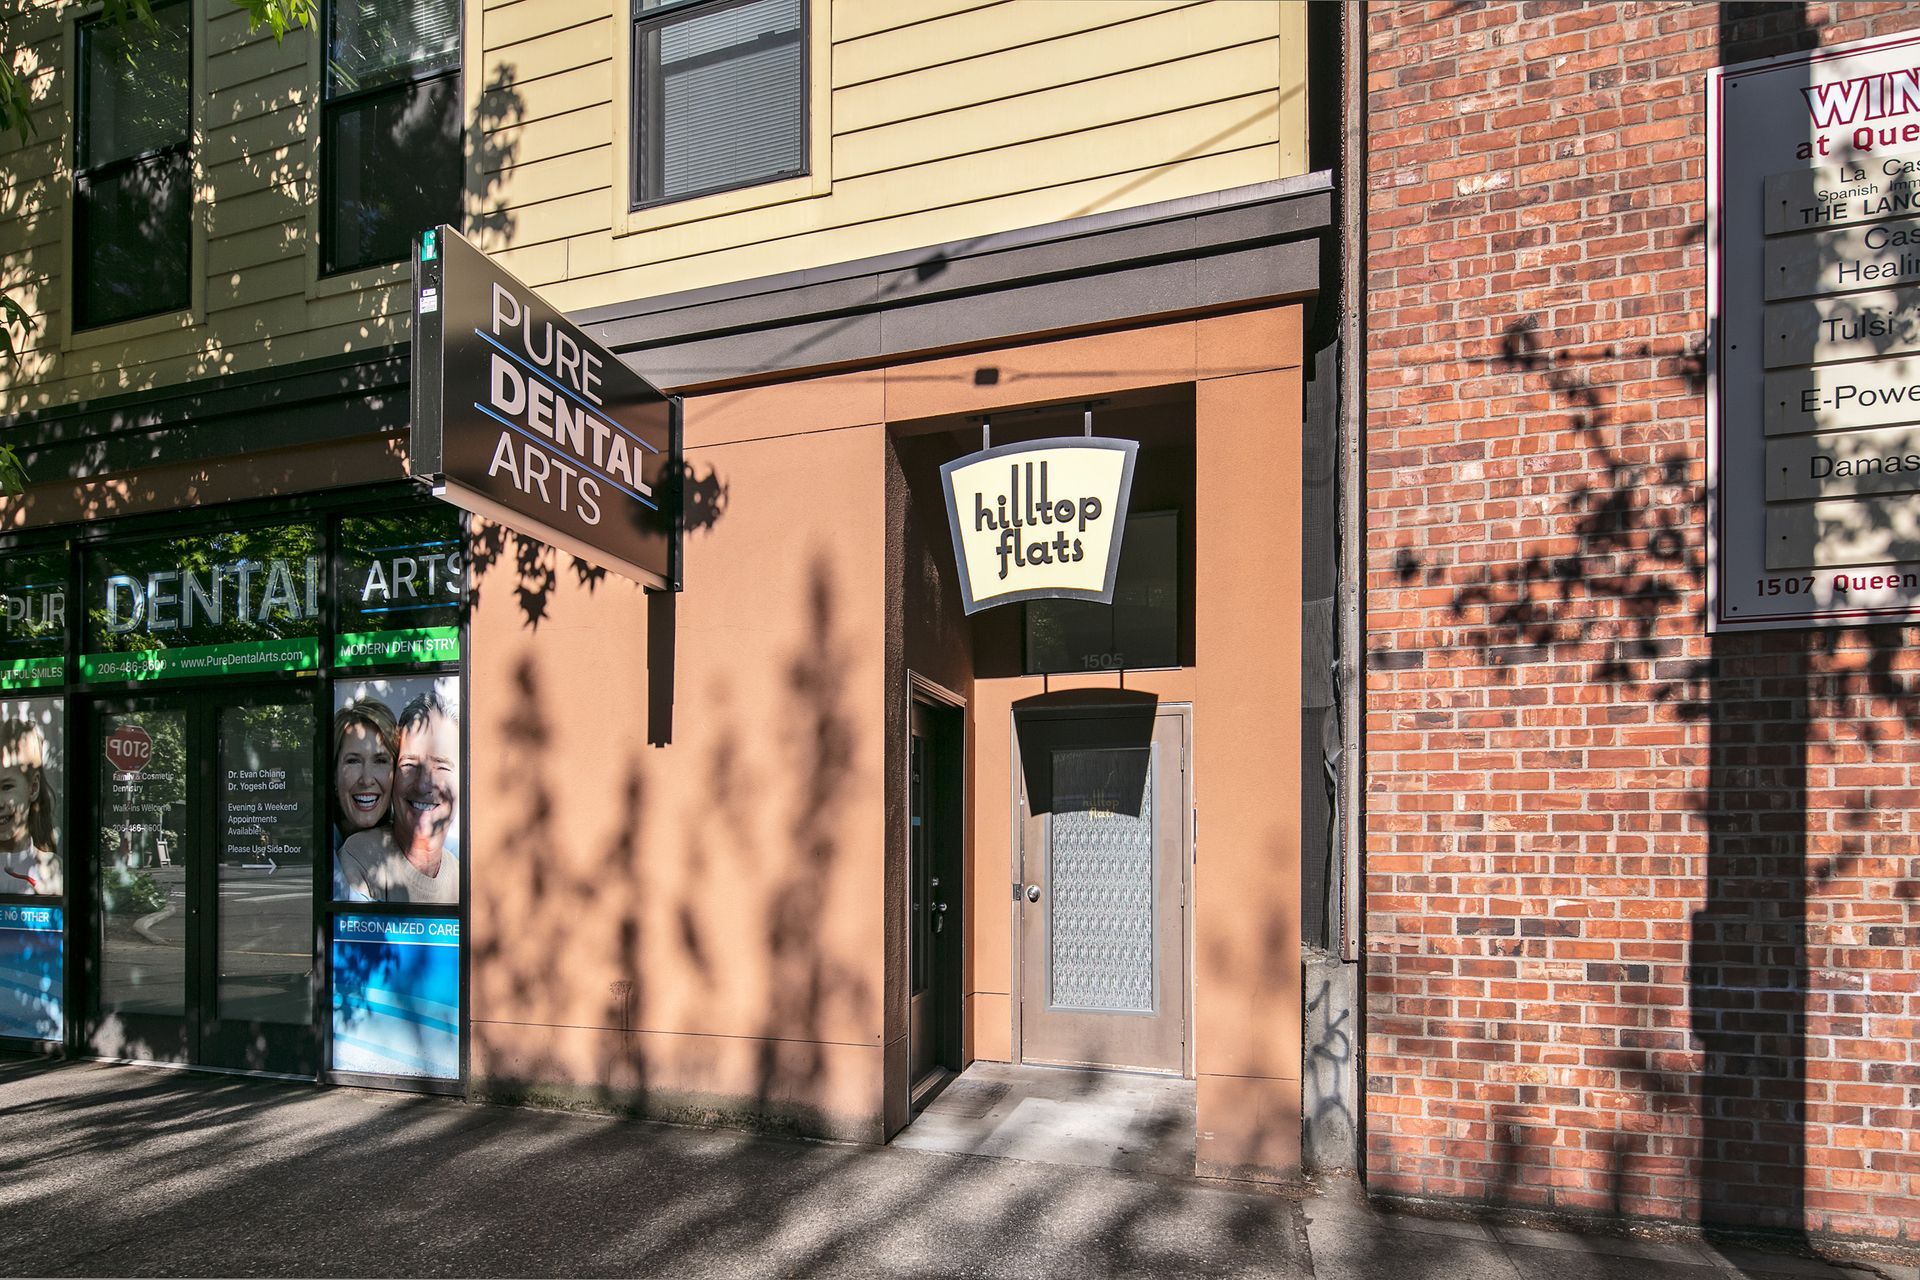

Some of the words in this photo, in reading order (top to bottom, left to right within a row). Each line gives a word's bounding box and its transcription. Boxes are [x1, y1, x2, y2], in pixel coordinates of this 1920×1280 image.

[1796, 135, 1830, 160] at
[1853, 123, 1920, 152] Que
[1841, 167, 1866, 183] La
[1882, 158, 1920, 176] Ca
[1817, 184, 1878, 204] Spanish
[1800, 203, 1848, 224] THE
[1823, 311, 1893, 342] Tulsi
[491, 282, 603, 406] PURE
[491, 352, 652, 497] DENTAL
[1810, 454, 1920, 479] Damas
[488, 431, 601, 525] ARTS
[975, 461, 1102, 532] hilltop
[996, 528, 1084, 580] flats
[6, 592, 65, 633] PUR
[361, 551, 460, 602] ARTS
[1757, 576, 1816, 596] 1507
[1833, 573, 1918, 593] Queen
[341, 641, 390, 657] MODERN
[391, 638, 457, 653] DENTISTRY
[181, 651, 303, 668] www.PureDentalArts.com
[1081, 653, 1125, 669] 1505
[31, 667, 63, 679] SMILES
[113, 772, 135, 781] Family
[142, 772, 174, 780] Cosmetic
[228, 770, 239, 779] Dr.
[240, 770, 258, 778] Evan
[259, 769, 286, 779] Chiang
[113, 784, 143, 793] Dentistry
[228, 782, 239, 791] Dr.
[240, 782, 267, 792] Yogesh
[268, 781, 286, 790] Goel
[228, 802, 256, 813] Evening
[257, 803, 263, 811] &
[264, 802, 298, 811] Weekend
[228, 815, 278, 825] Appointments
[227, 844, 251, 853] Please
[251, 844, 266, 853] Use
[267, 844, 283, 853] Side
[284, 844, 302, 853] Door
[4, 910, 18, 921] NO
[21, 911, 50, 922] OTHER
[340, 920, 425, 935] PERSONALIZED
[428, 923, 460, 936] CARE
